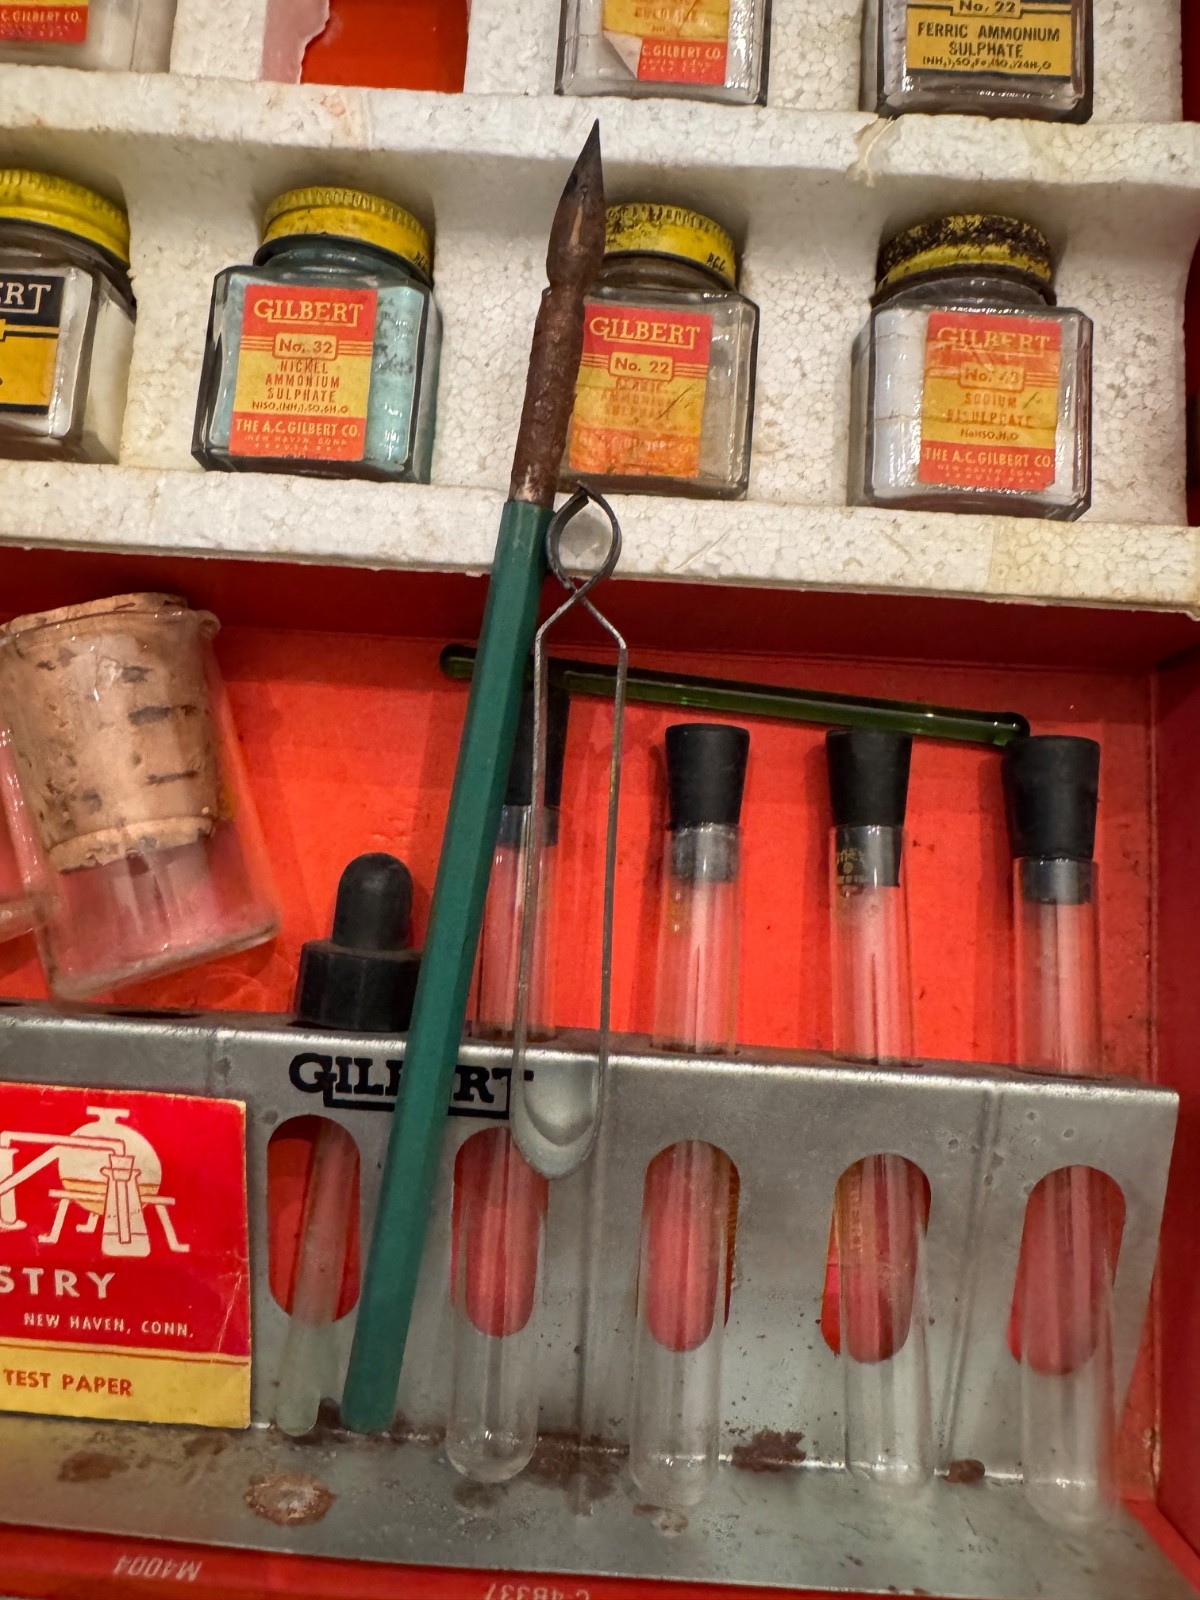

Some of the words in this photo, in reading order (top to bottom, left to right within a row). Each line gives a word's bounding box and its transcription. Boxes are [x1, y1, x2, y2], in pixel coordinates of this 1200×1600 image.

[13, 10, 60, 23] GILBERT
[917, 22, 968, 38] FERRIC
[977, 24, 1060, 42] AMMONIUM
[653, 44, 701, 58] GILBERT
[949, 41, 1024, 58] SULPHATE
[253, 298, 364, 327] GILBERT
[589, 316, 700, 349] GILBERT
[278, 339, 308, 353] No.
[313, 341, 333, 354] 32
[936, 326, 1050, 358] GILBERT
[280, 360, 328, 375] NICKEL
[615, 357, 641, 372] No.
[649, 361, 670, 374] 22
[265, 373, 340, 389] AMMONIUM
[965, 367, 992, 382] No.
[267, 388, 336, 403] SULPHATE
[964, 392, 1017, 409] SODIUM
[236, 418, 259, 433] THE
[262, 420, 286, 434] A.C.
[288, 421, 338, 436] GILBERT
[342, 424, 360, 437] CO.
[925, 447, 948, 462] THE
[978, 452, 1028, 467] GILBERT
[1034, 455, 1054, 468] CO.
[24, 1313, 60, 1328] NEW
[69, 1315, 131, 1334] HAVEN,
[141, 1320, 194, 1339] CONN.
[2, 1368, 51, 1390] TEST
[62, 1373, 133, 1397] PAPER
